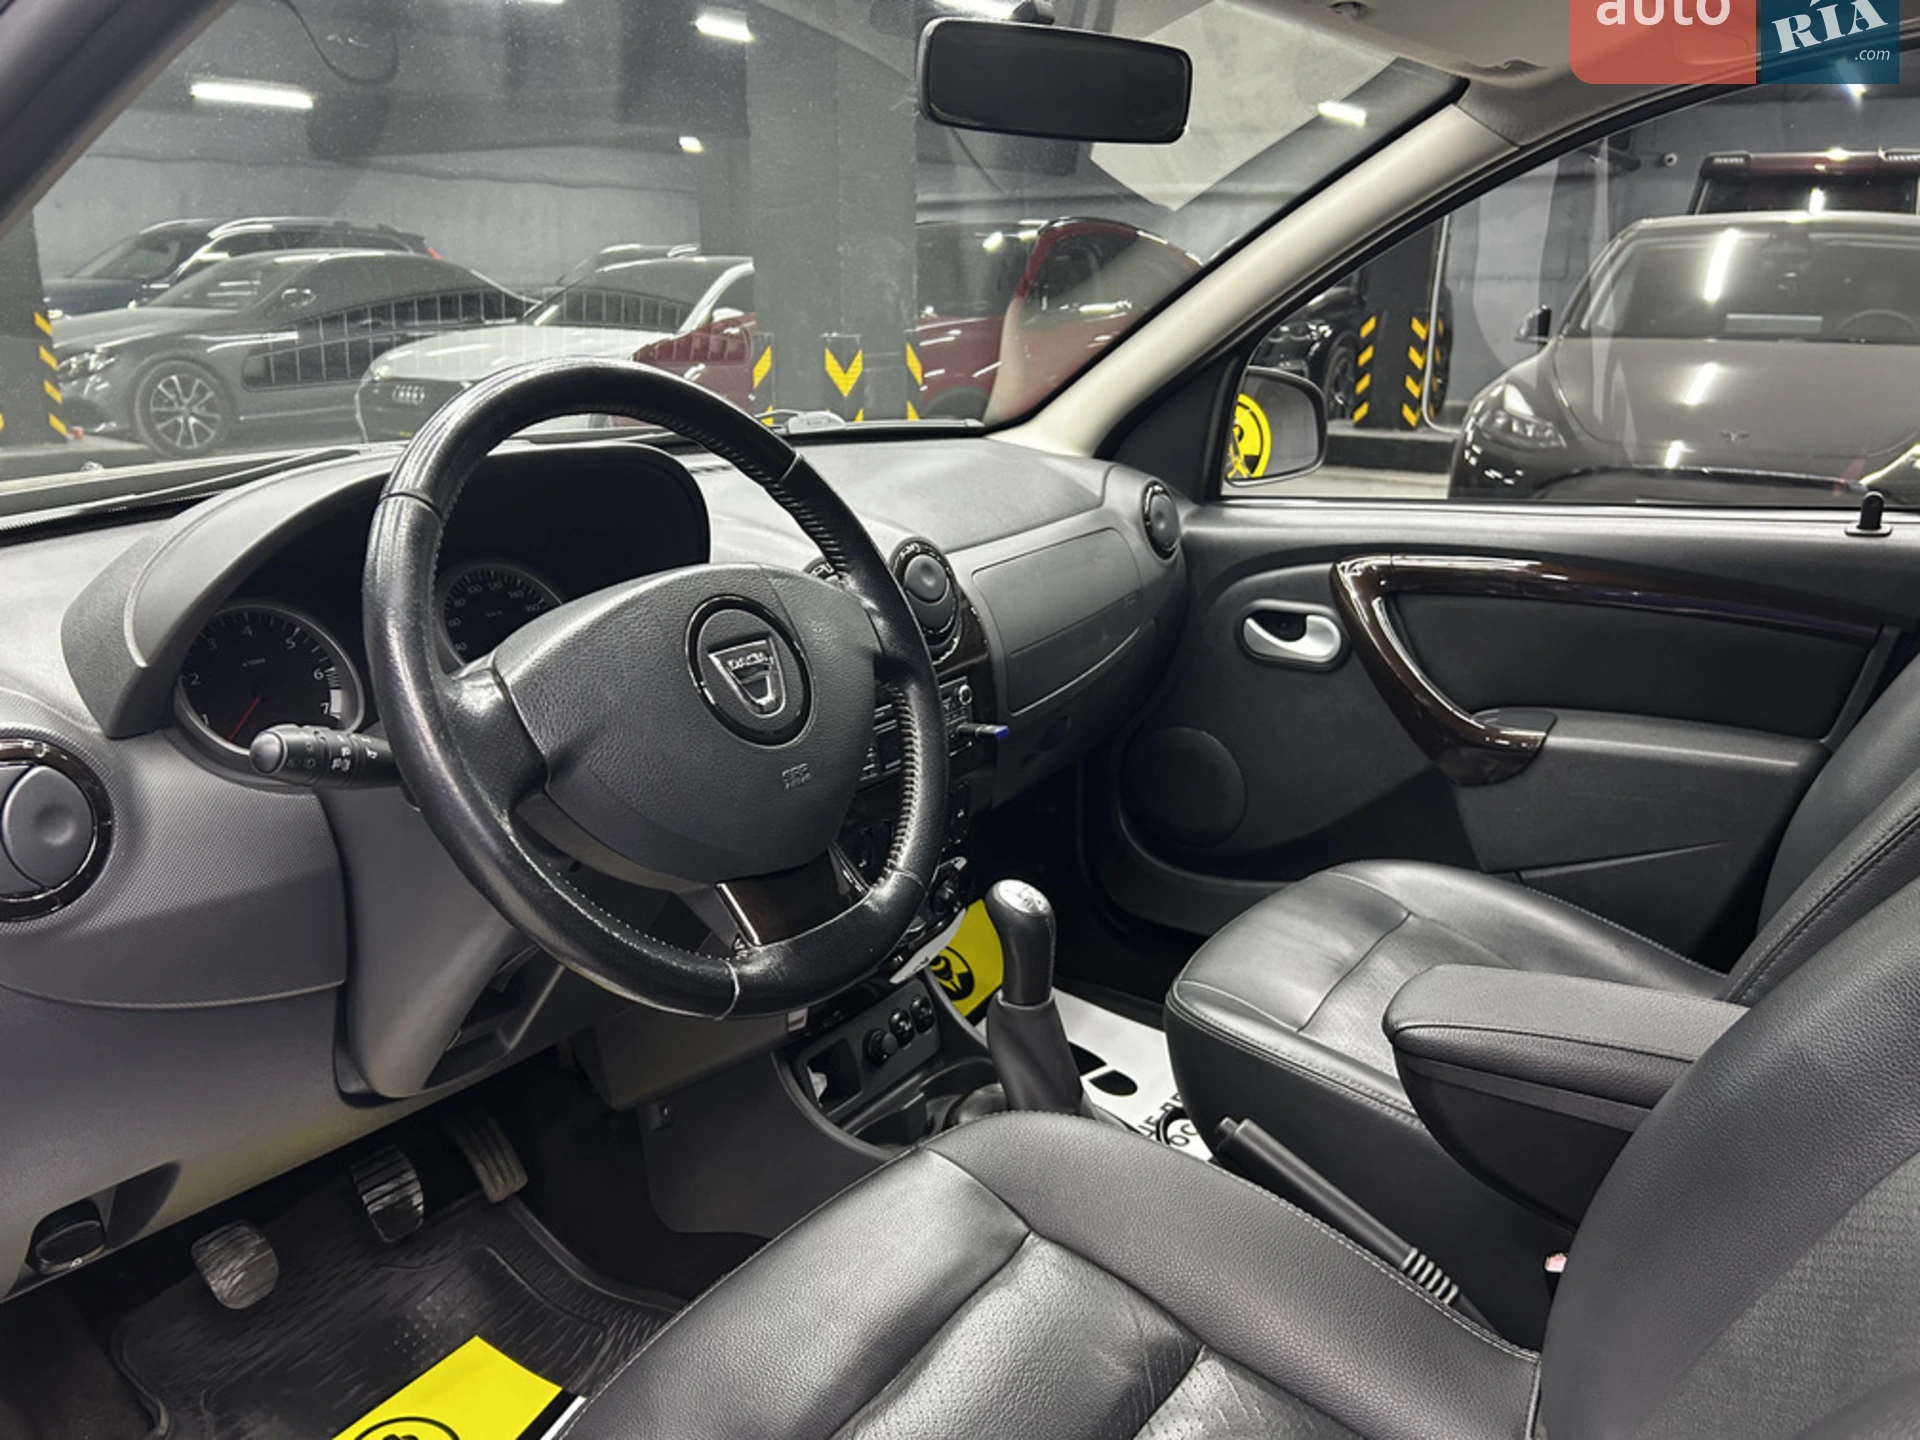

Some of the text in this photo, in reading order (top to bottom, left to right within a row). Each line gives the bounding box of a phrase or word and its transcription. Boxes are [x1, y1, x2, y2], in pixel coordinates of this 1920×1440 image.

[285, 637, 296, 650] 5
[190, 672, 200, 685] 2
[313, 668, 325, 681] 6
[320, 702, 330, 715] 7
